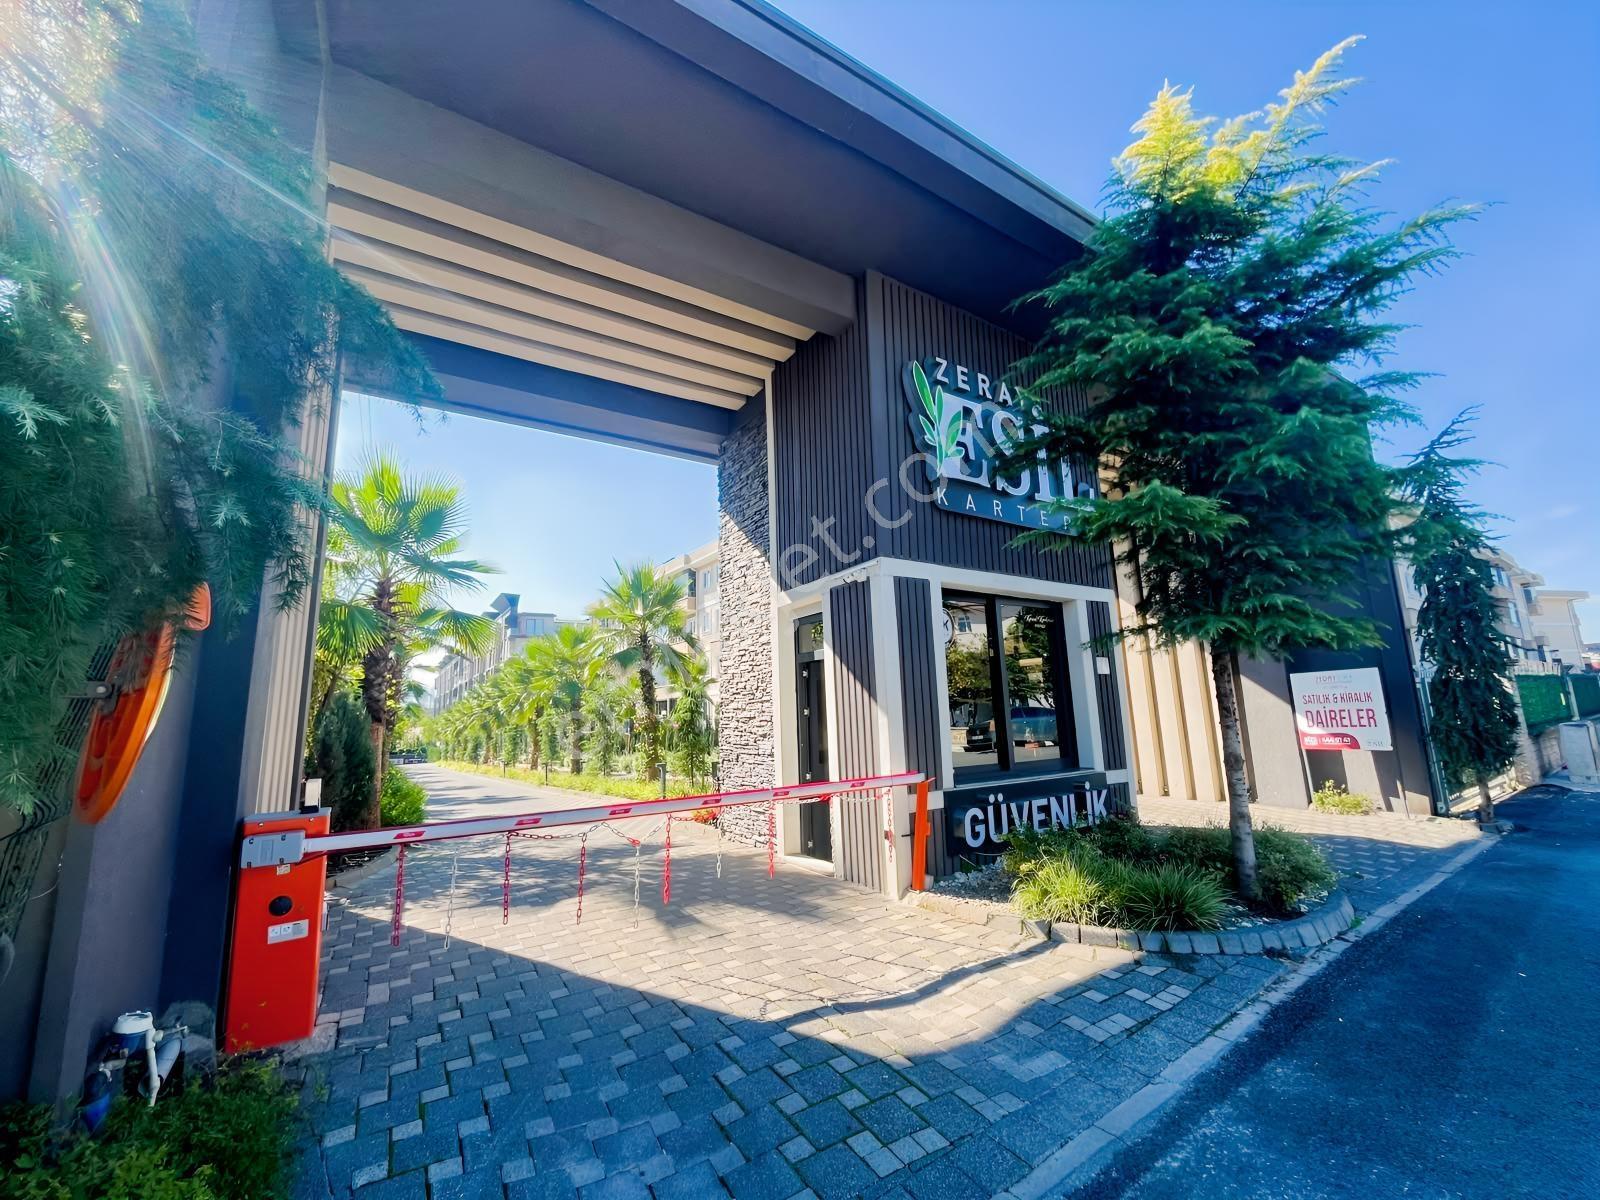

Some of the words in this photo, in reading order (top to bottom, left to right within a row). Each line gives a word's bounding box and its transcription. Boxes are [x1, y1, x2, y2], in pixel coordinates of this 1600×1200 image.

[936, 487, 1073, 531] KARTEP
[1302, 693, 1331, 705] SATILIK
[1340, 691, 1373, 703] KİRALIK
[1305, 706, 1378, 728] DAİRELER
[964, 781, 1108, 848] GÜVENLİK
